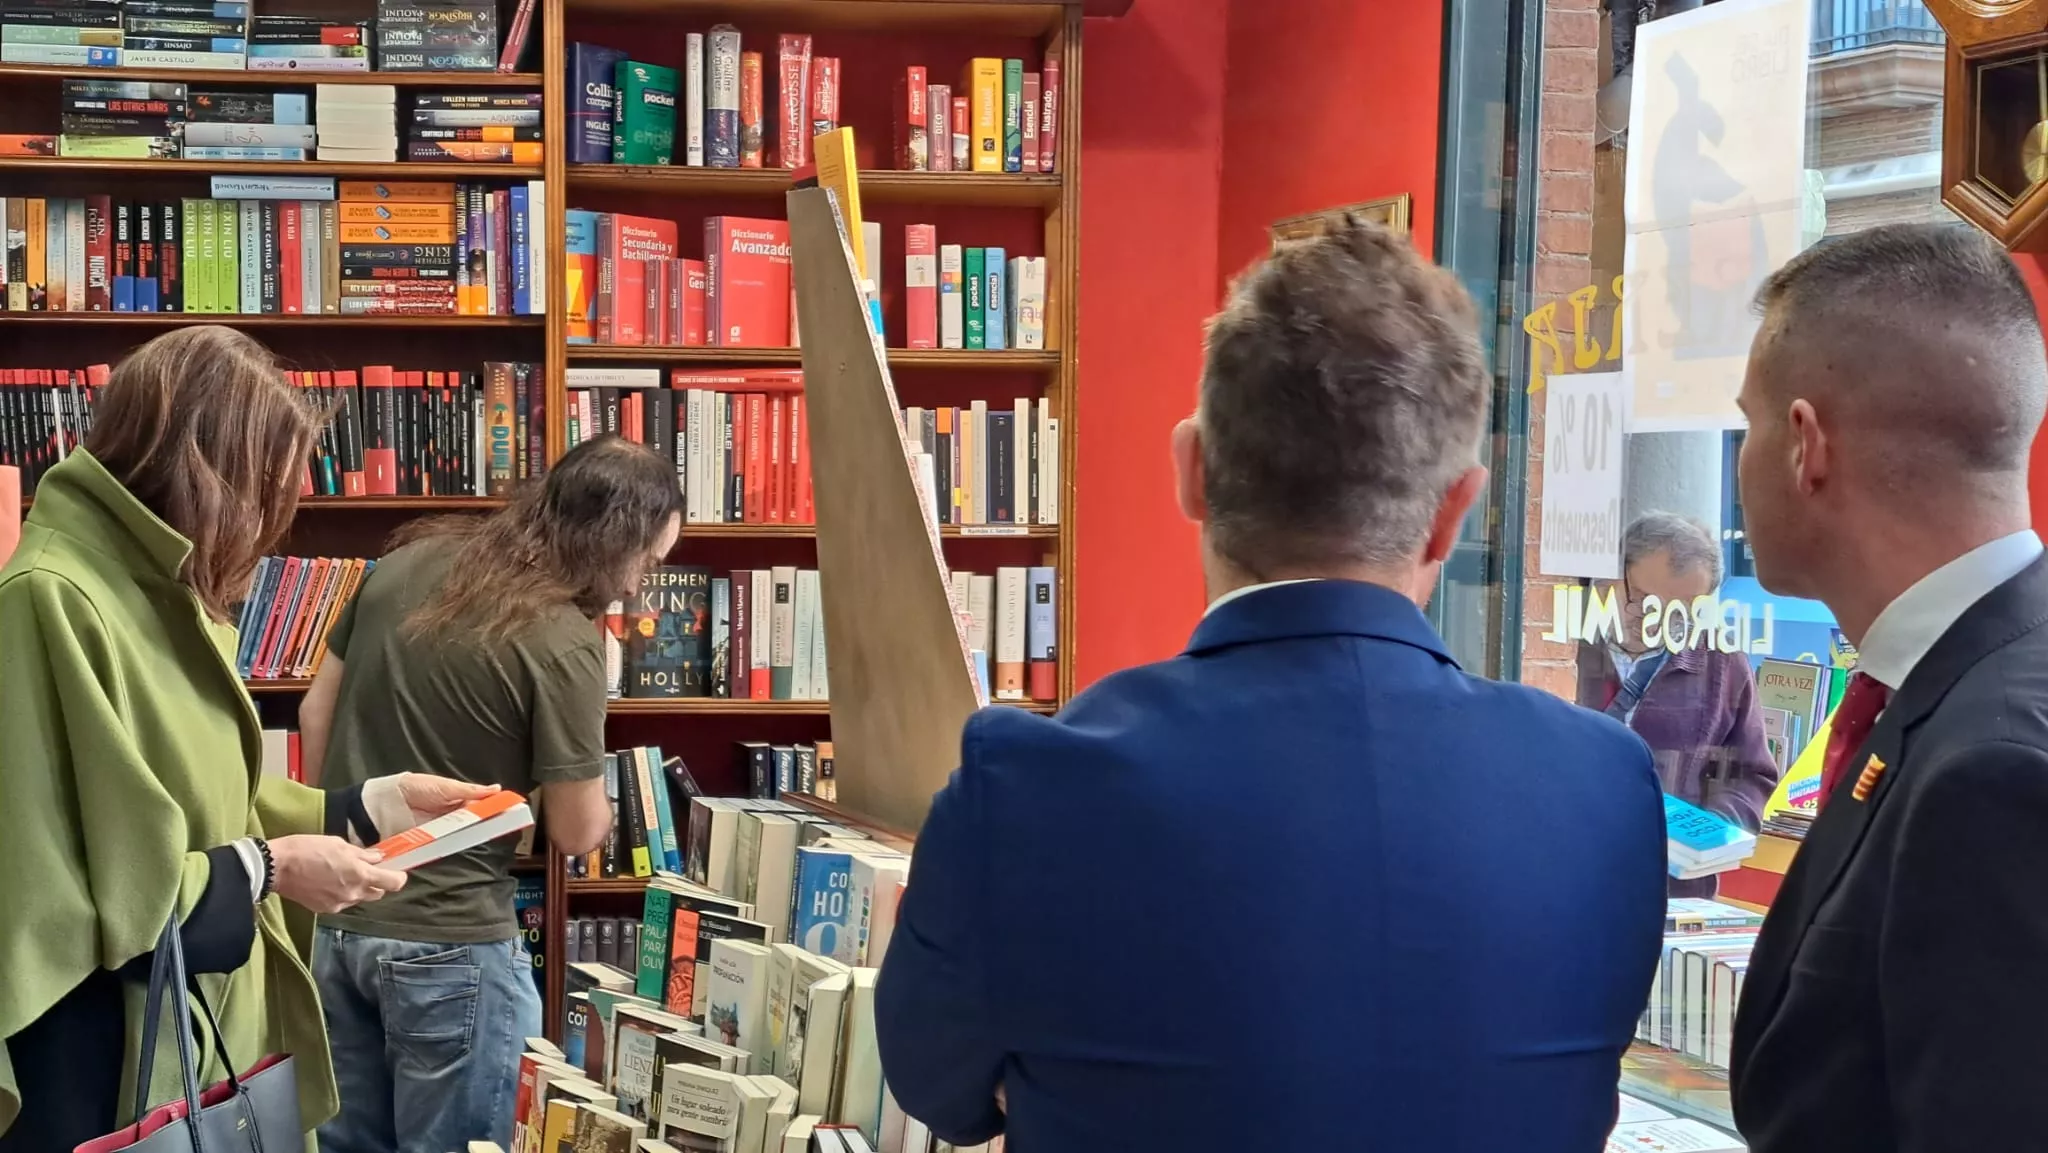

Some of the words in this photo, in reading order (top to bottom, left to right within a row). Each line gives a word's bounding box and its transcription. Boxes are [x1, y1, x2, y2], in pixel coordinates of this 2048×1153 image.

[385, 10, 423, 18] PAOLINI
[428, 10, 473, 21] BRISINGR
[385, 32, 423, 41] PAOLINI
[386, 54, 423, 62] PAOLINI
[428, 55, 474, 66] ERAGON
[615, 91, 623, 122] pocket
[643, 93, 675, 106] pocket
[981, 88, 993, 126] Manual
[1007, 93, 1017, 126] Manual
[1041, 90, 1053, 131] Ilustrado
[1024, 101, 1035, 139] Esencial
[186, 203, 194, 235] CIXIN
[203, 203, 212, 235] CIXIN
[224, 203, 232, 235] CIXIN
[264, 206, 272, 231] JAVIER
[515, 212, 524, 233] Sade
[731, 229, 775, 241] Diccionario
[186, 239, 194, 258] LIU
[203, 239, 212, 258] LIU
[224, 239, 232, 258] LIU
[264, 233, 272, 269] CASTILLO
[414, 246, 451, 257] KING
[622, 237, 666, 252] Secundaria
[666, 244, 673, 253] y
[731, 241, 792, 256] Avanzado
[89, 255, 105, 288] NUNCA
[707, 254, 715, 297] Avanzado
[970, 276, 979, 307] pocket
[990, 274, 998, 308] esencial
[608, 405, 616, 432] Contra
[490, 426, 511, 480] DUNE
[642, 573, 707, 587] STEPHEN
[640, 591, 707, 613] KING
[640, 672, 704, 686] HOLLY
[1764, 673, 1792, 688] ¡OTRA
[1792, 674, 1814, 690] VEZ!
[829, 872, 848, 888] CO
[647, 895, 669, 907] NAT
[813, 890, 844, 917] HO
[646, 926, 668, 940] PALA
[642, 956, 665, 969] OLIV
[624, 1053, 652, 1074] LIENZ
[635, 1074, 647, 1087] DE
[671, 1093, 680, 1105] Un
[681, 1095, 698, 1112] lugar
[699, 1102, 726, 1116] soleado
[680, 1108, 698, 1121] gente
